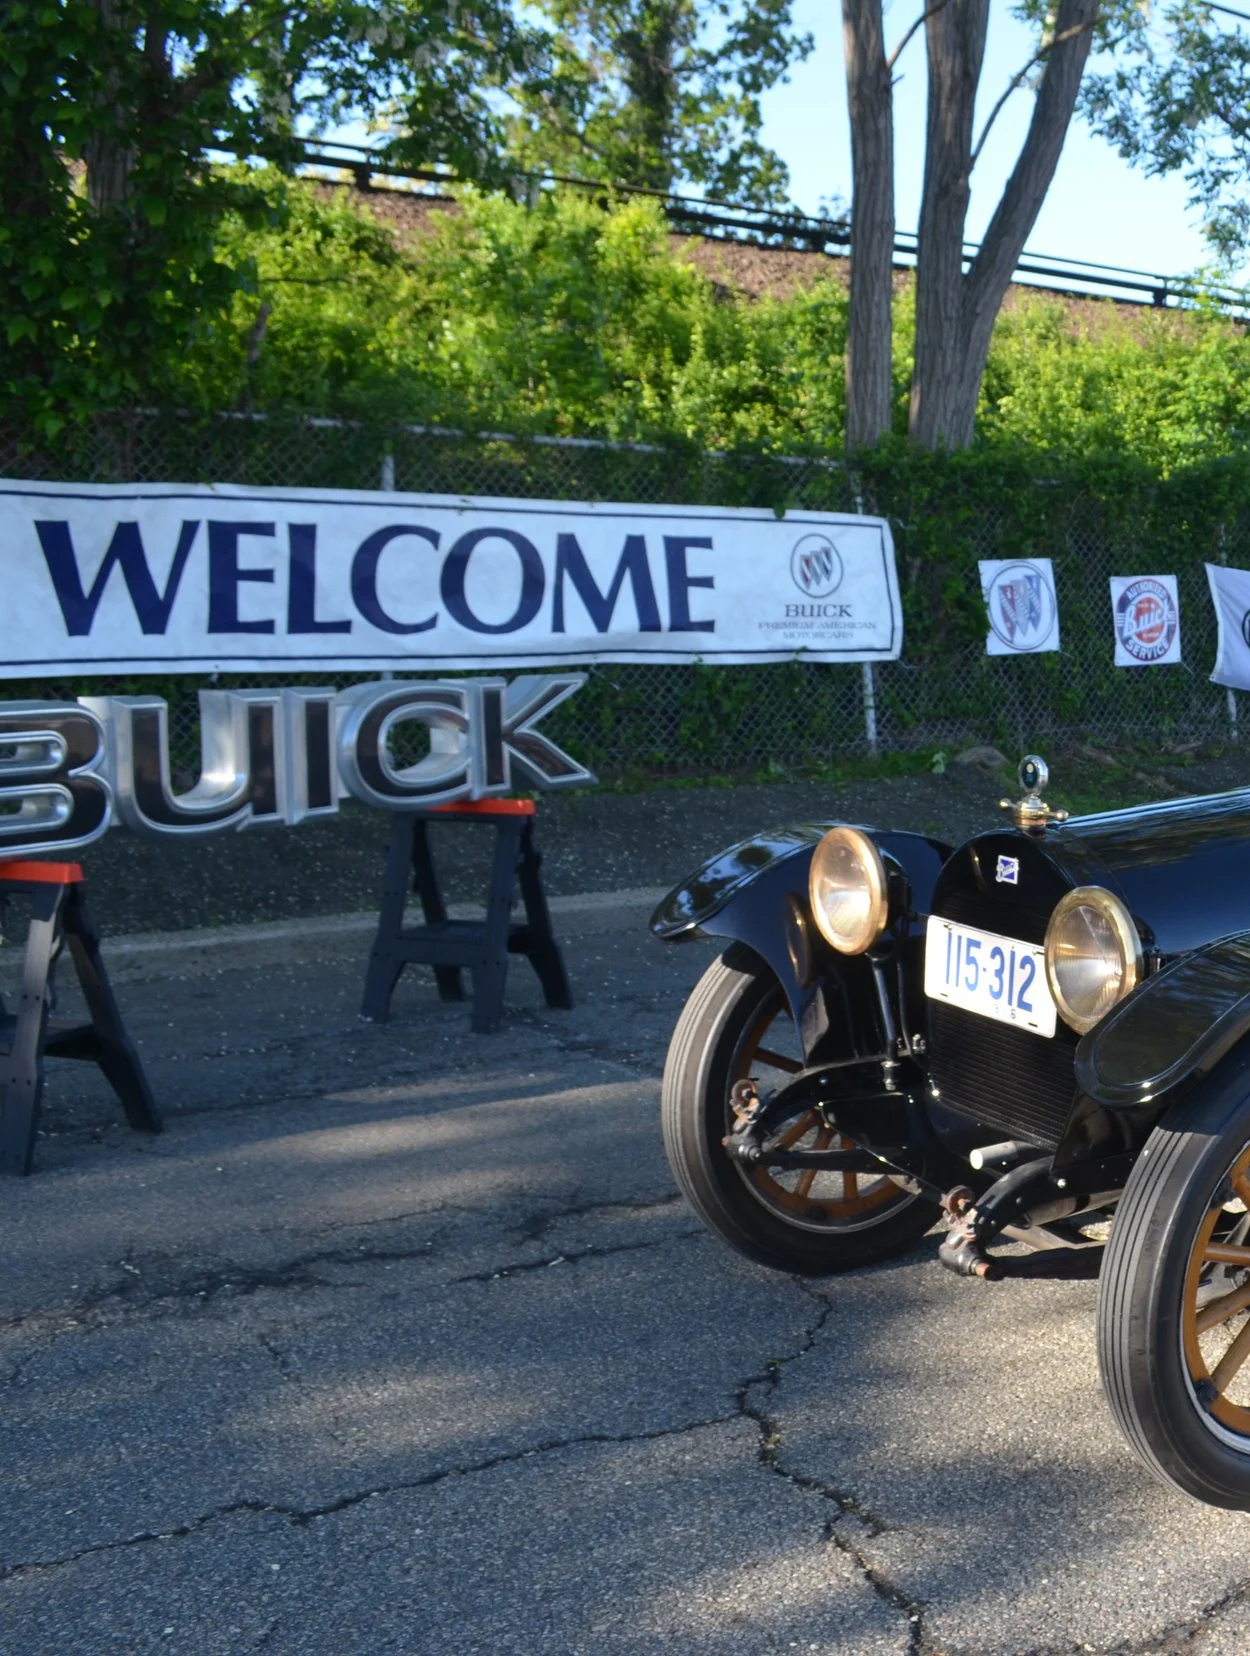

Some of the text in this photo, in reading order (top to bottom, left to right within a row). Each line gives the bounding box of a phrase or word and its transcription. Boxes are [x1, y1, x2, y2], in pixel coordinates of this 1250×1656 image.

[34, 519, 714, 635] WELCOME
[785, 604, 853, 617] BUICK
[817, 622, 877, 630] AMERICAN
[1126, 639, 1169, 660] SERVICE
[0, 673, 598, 856] BUICK
